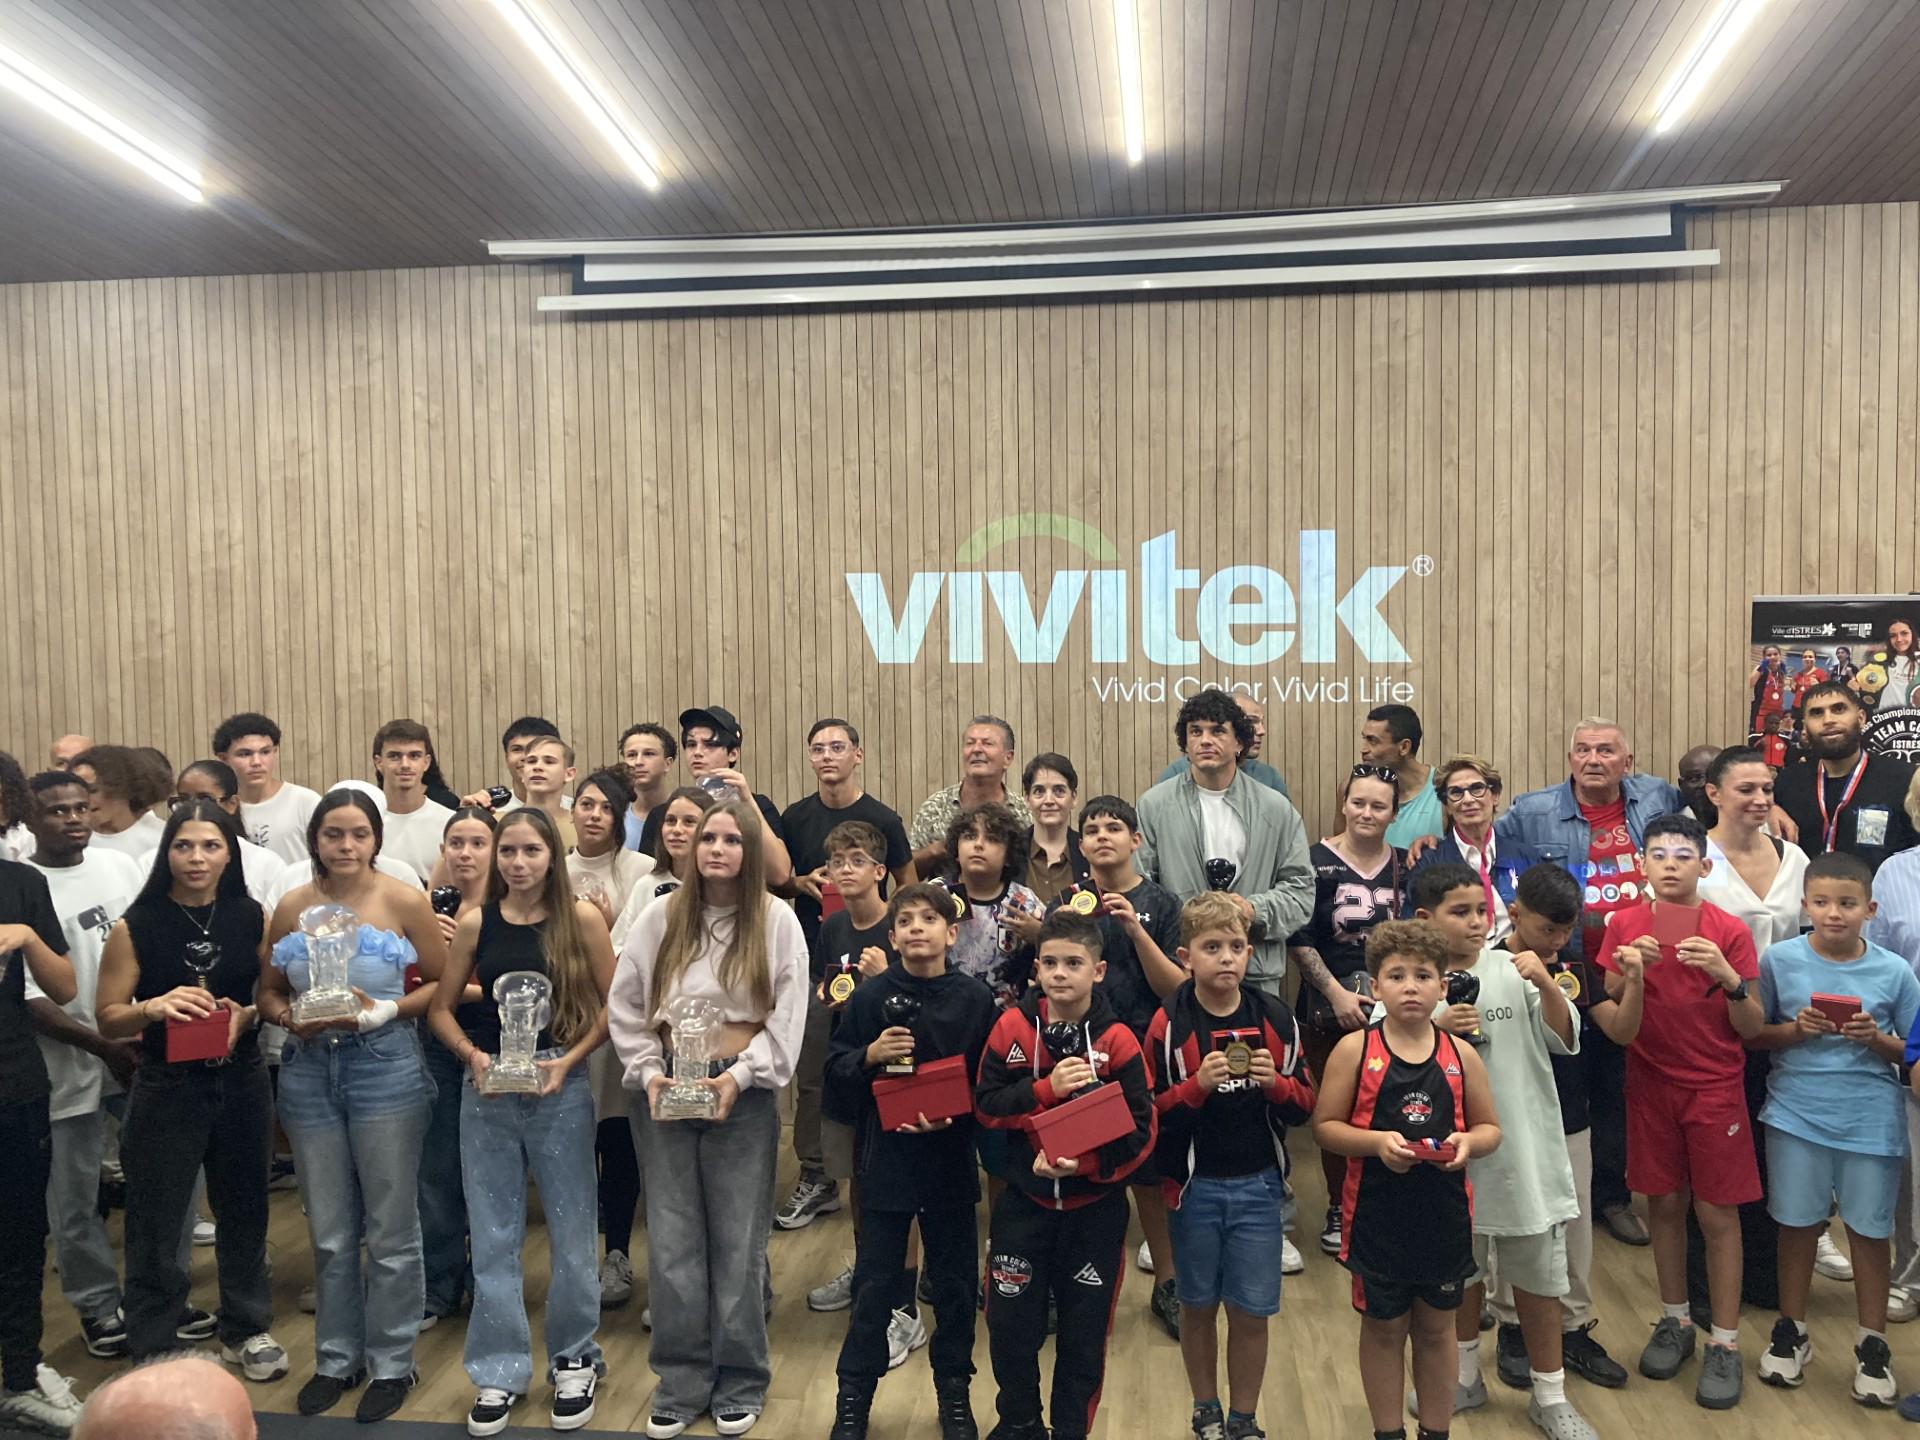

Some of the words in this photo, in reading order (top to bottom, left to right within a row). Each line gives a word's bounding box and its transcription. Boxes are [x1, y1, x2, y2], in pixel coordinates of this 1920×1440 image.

[1091, 676, 1166, 702] Vivid
[1272, 676, 1349, 702] Vivid
[1359, 676, 1415, 702] Life
[1872, 707, 1920, 723] Champions
[1874, 720, 1906, 741] TEAM
[1485, 1006, 1513, 1022] GOD
